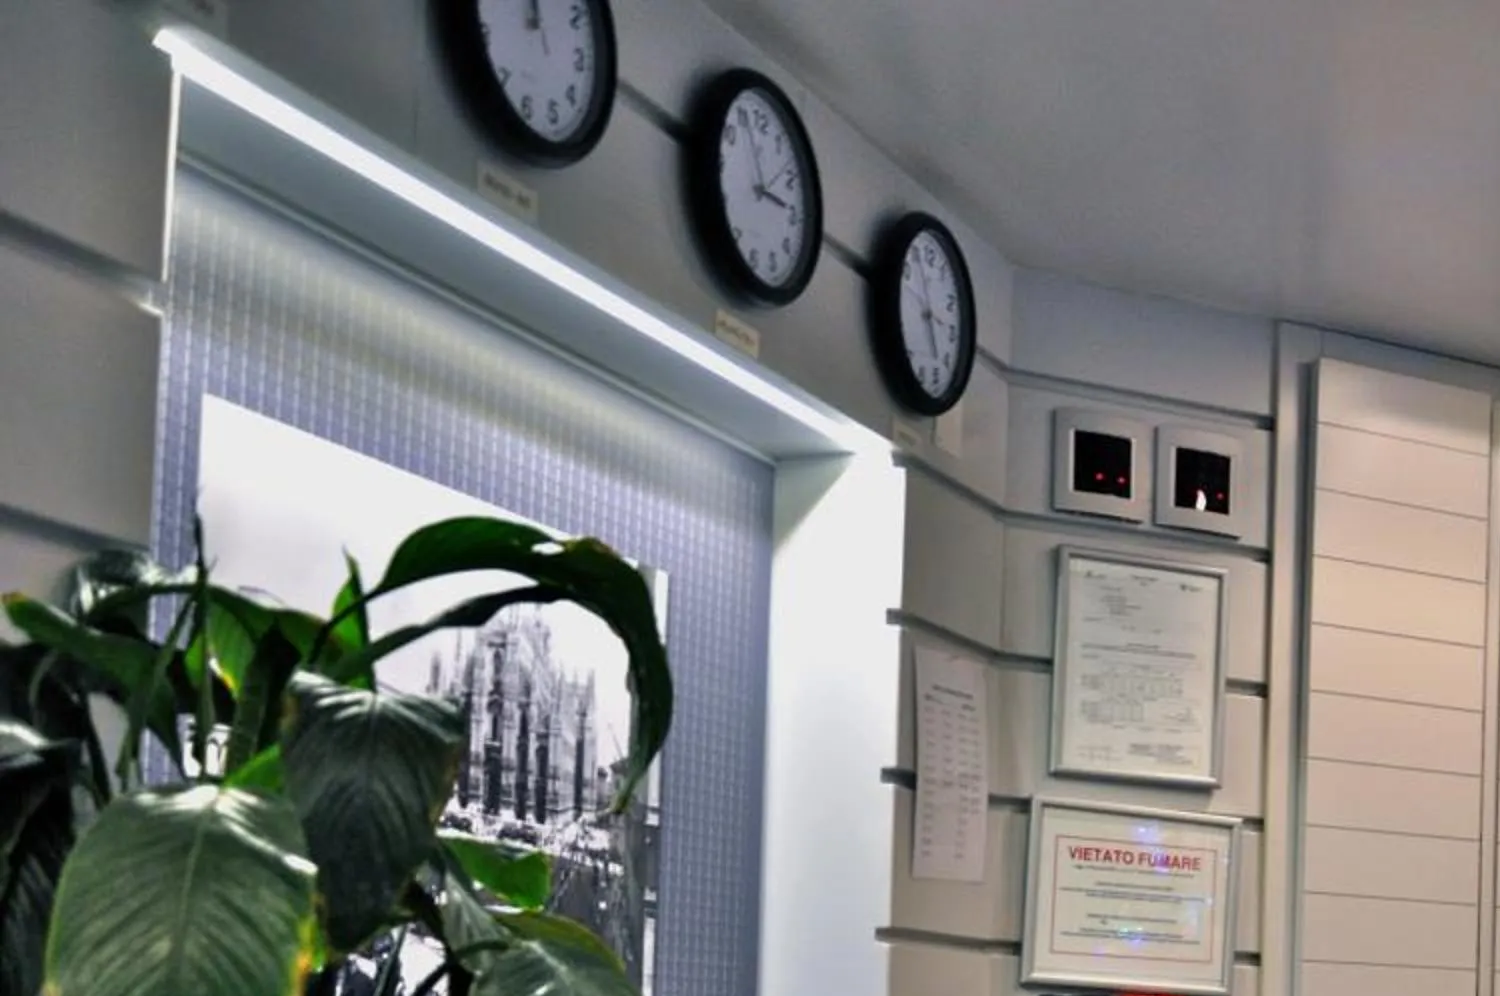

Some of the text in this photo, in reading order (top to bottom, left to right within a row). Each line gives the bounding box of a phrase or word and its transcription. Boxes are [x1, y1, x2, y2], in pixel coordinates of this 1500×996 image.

[573, 47, 585, 72] 3
[521, 95, 533, 120] 6
[565, 84, 577, 107] 4
[549, 99, 560, 124] 5
[753, 109, 769, 135] 12
[1069, 846, 1202, 870] VIETATO FUMARE
